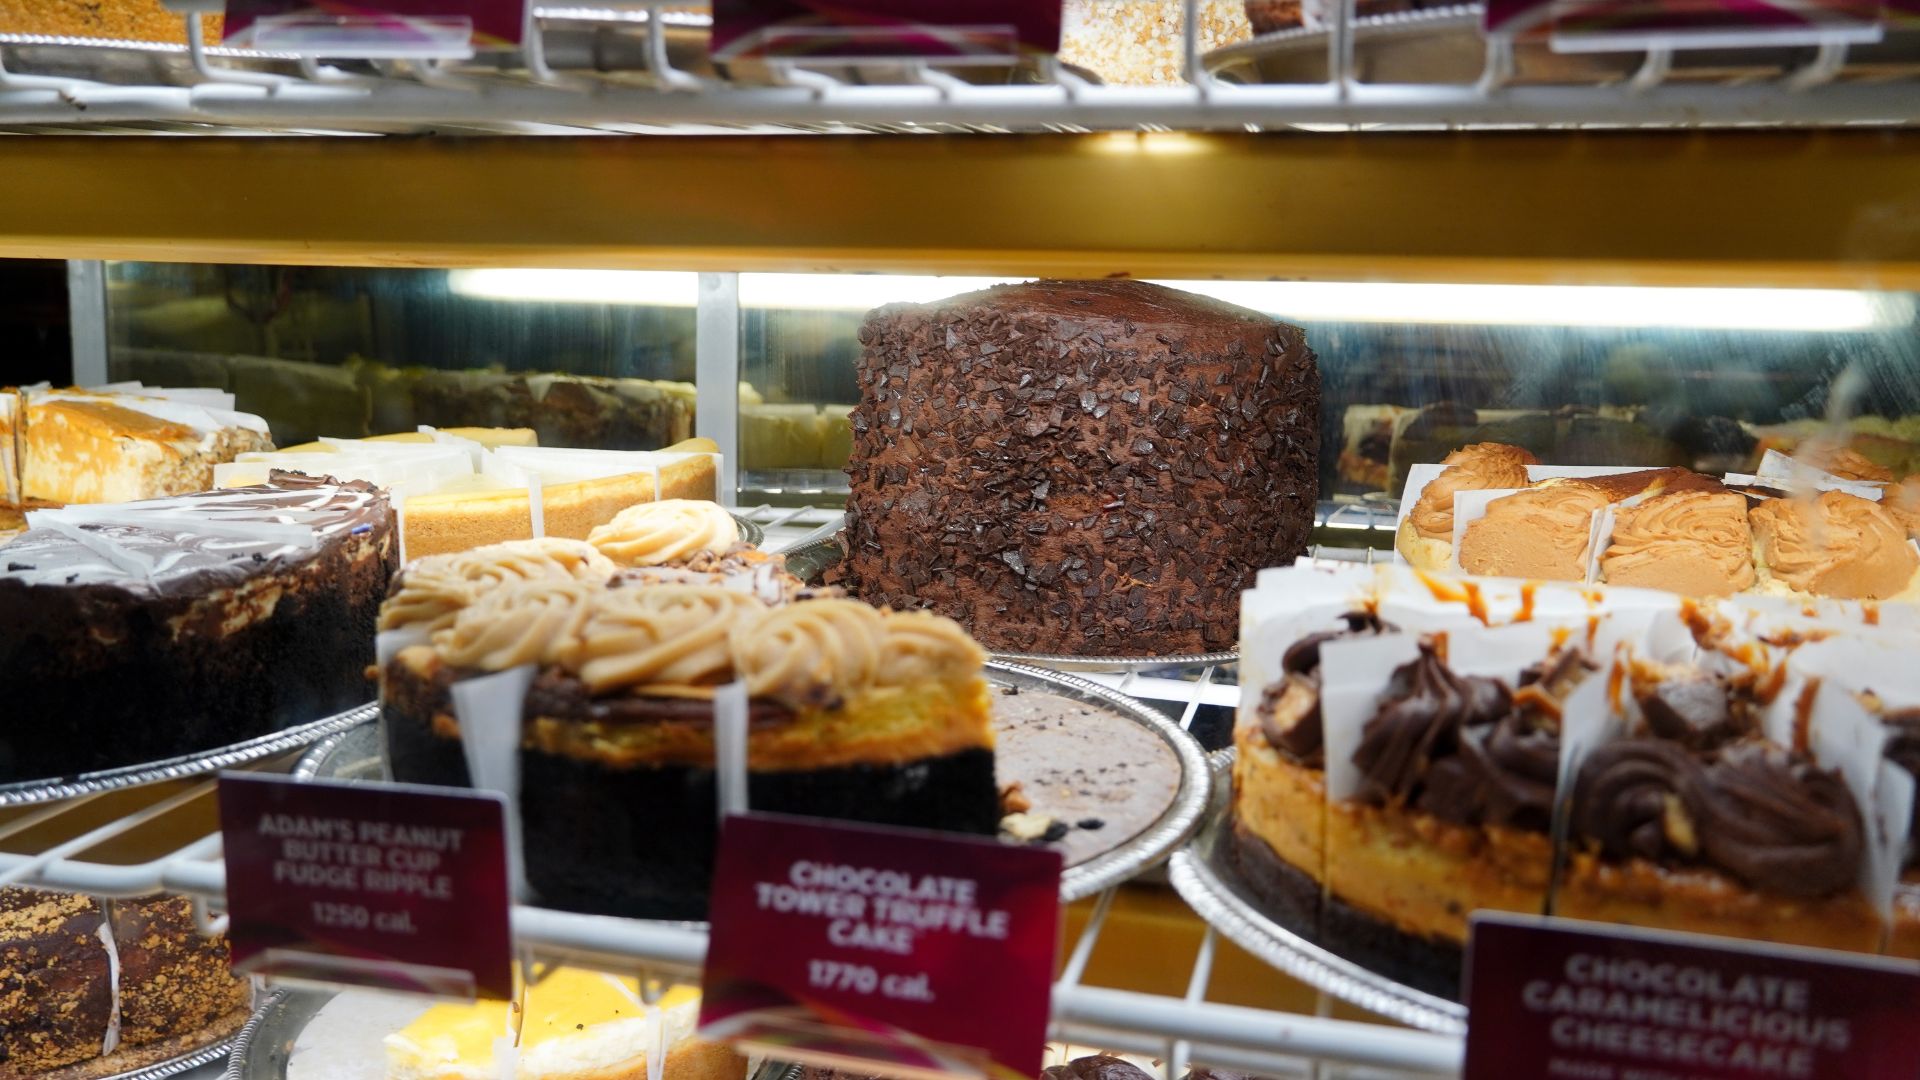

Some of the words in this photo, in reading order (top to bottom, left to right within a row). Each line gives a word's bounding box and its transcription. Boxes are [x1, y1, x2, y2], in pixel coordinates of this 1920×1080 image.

[258, 814, 352, 840] ADAM'S
[359, 822, 463, 850] PEANUT
[283, 839, 381, 866] BUTTER
[387, 848, 440, 872] CUP
[274, 862, 358, 889] FUDGE
[364, 871, 452, 898] RIPPLE
[789, 860, 977, 905] CHOCOLATE
[312, 902, 370, 929] 1250
[375, 911, 416, 933] cal.
[756, 882, 866, 919] TOWER
[875, 898, 1009, 939] TRUFFLE
[828, 920, 914, 954] CAKE
[808, 959, 877, 993] 1770
[882, 973, 935, 1001] cal.
[1566, 953, 1808, 1010] CHOCOLATE
[1523, 980, 1849, 1050] CARAMELICIOUS
[1550, 1015, 1815, 1077] CHEESECAKE
